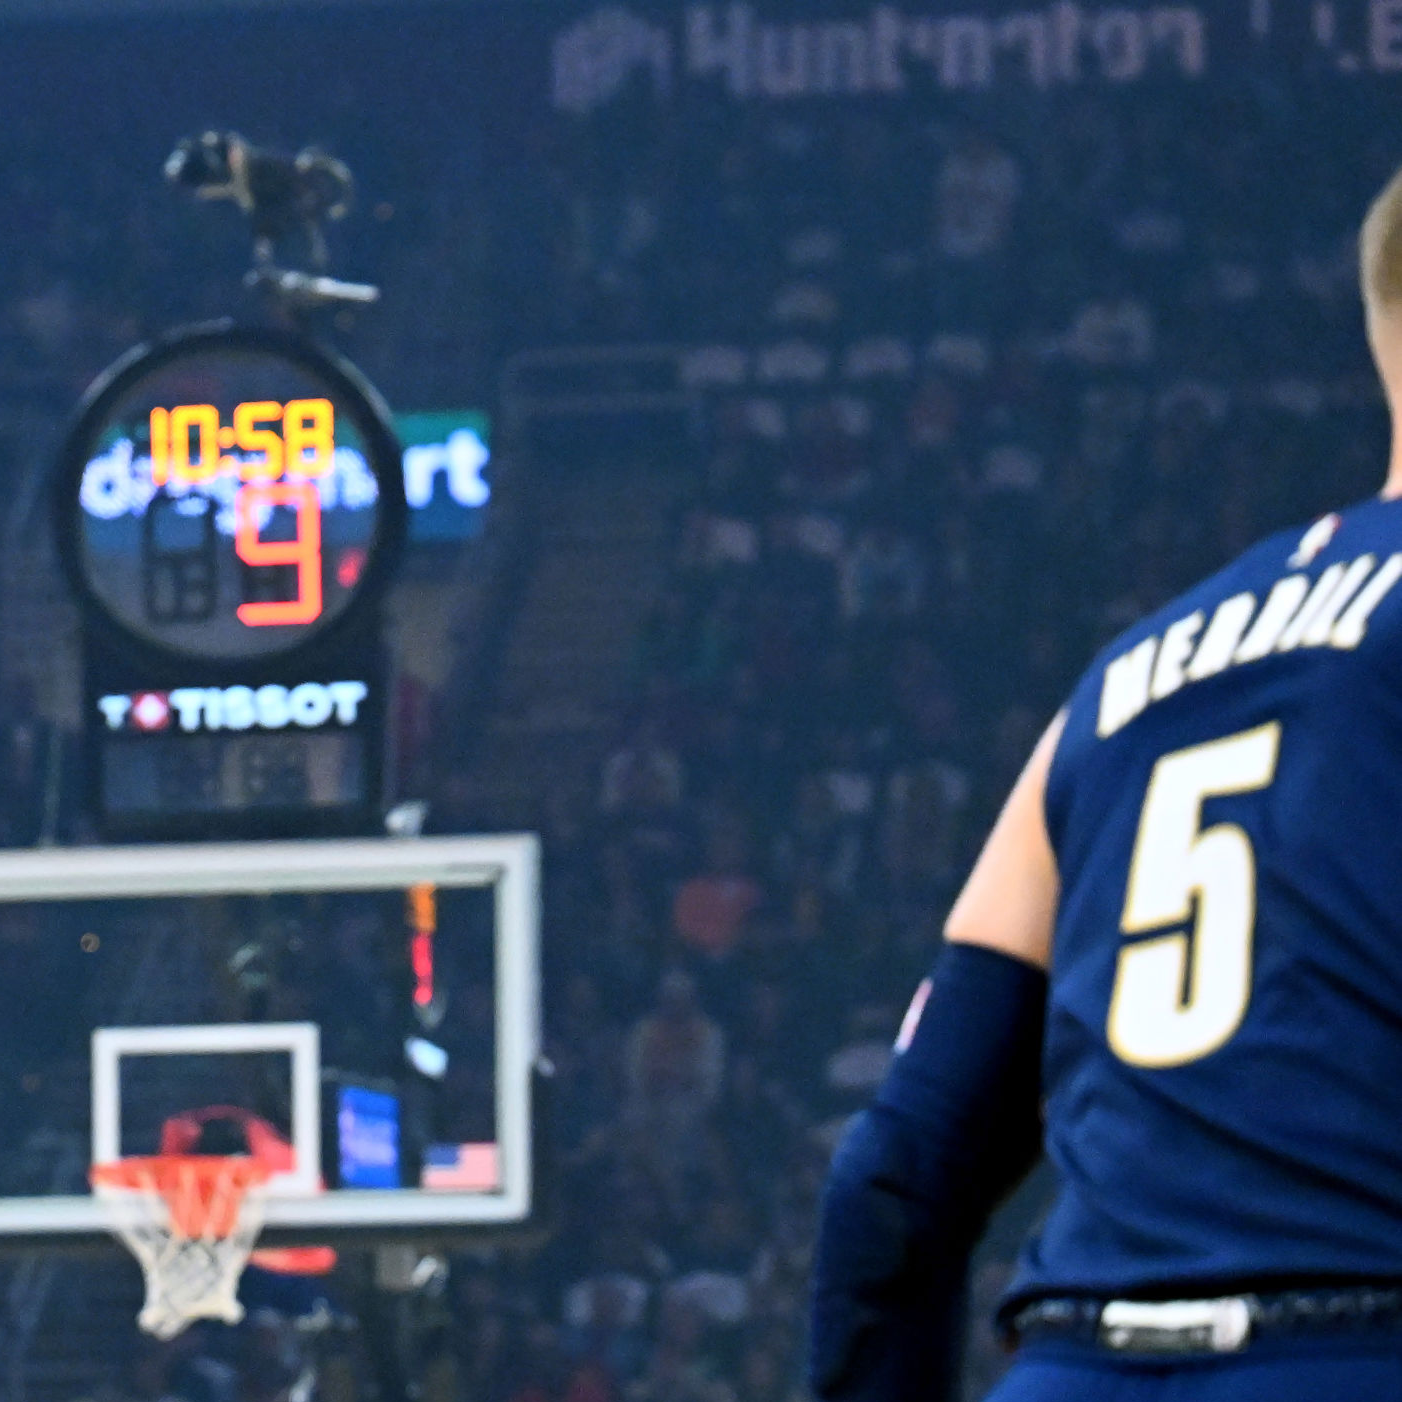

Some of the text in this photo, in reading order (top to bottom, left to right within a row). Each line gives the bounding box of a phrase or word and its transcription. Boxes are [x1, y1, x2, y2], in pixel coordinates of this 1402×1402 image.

[150, 398, 335, 486] 10:58
[235, 481, 322, 627] 9
[169, 681, 367, 732] TISSOT
[1107, 720, 1282, 1069] 5
